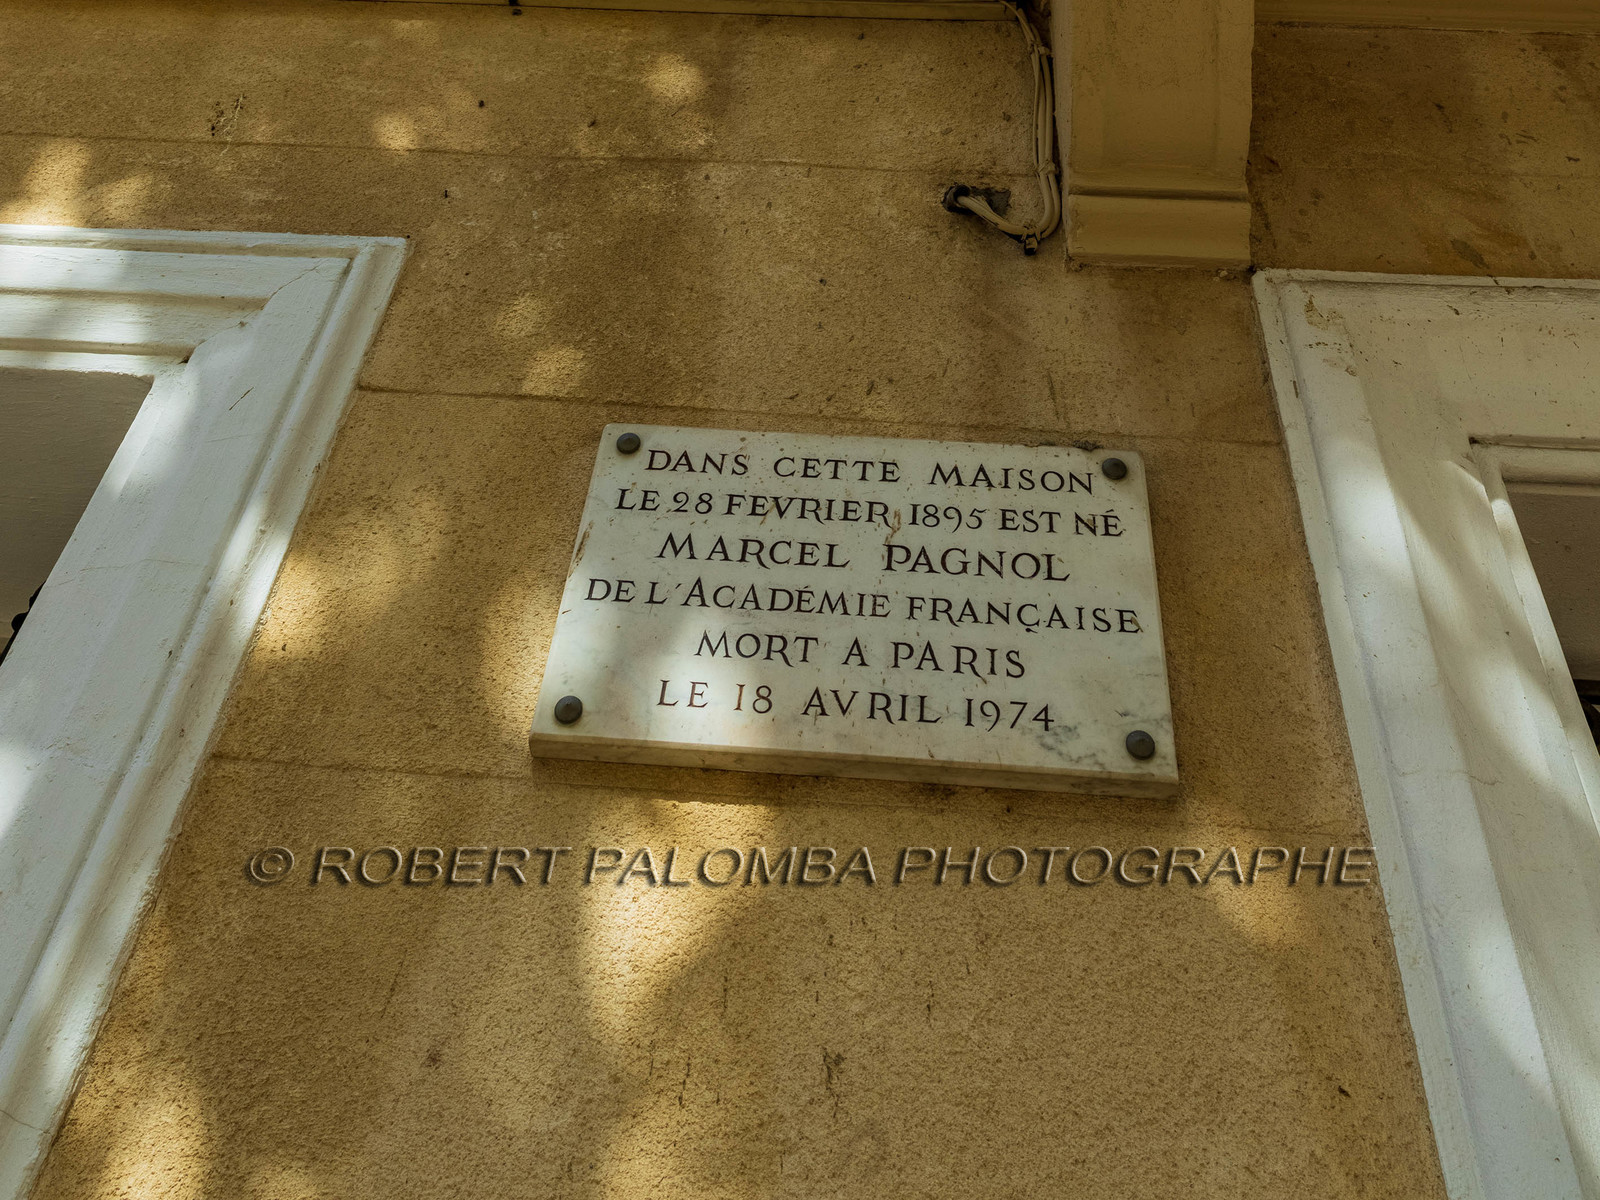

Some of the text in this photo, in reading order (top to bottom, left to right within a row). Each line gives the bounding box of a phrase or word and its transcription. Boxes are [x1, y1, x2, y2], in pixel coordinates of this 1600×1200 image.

[645, 450, 1093, 495] DANS CETTE MAISON
[615, 488, 1123, 537] LE 28 FEVRIER 1895 EST NÉ
[655, 532, 1070, 582] MARCEL PAGNOL
[584, 578, 635, 602] DE
[905, 595, 1141, 634] FRANÇAISE
[694, 630, 1026, 683] MORT A PARIS
[656, 679, 1055, 732] LE 18 AVRIL 1974
